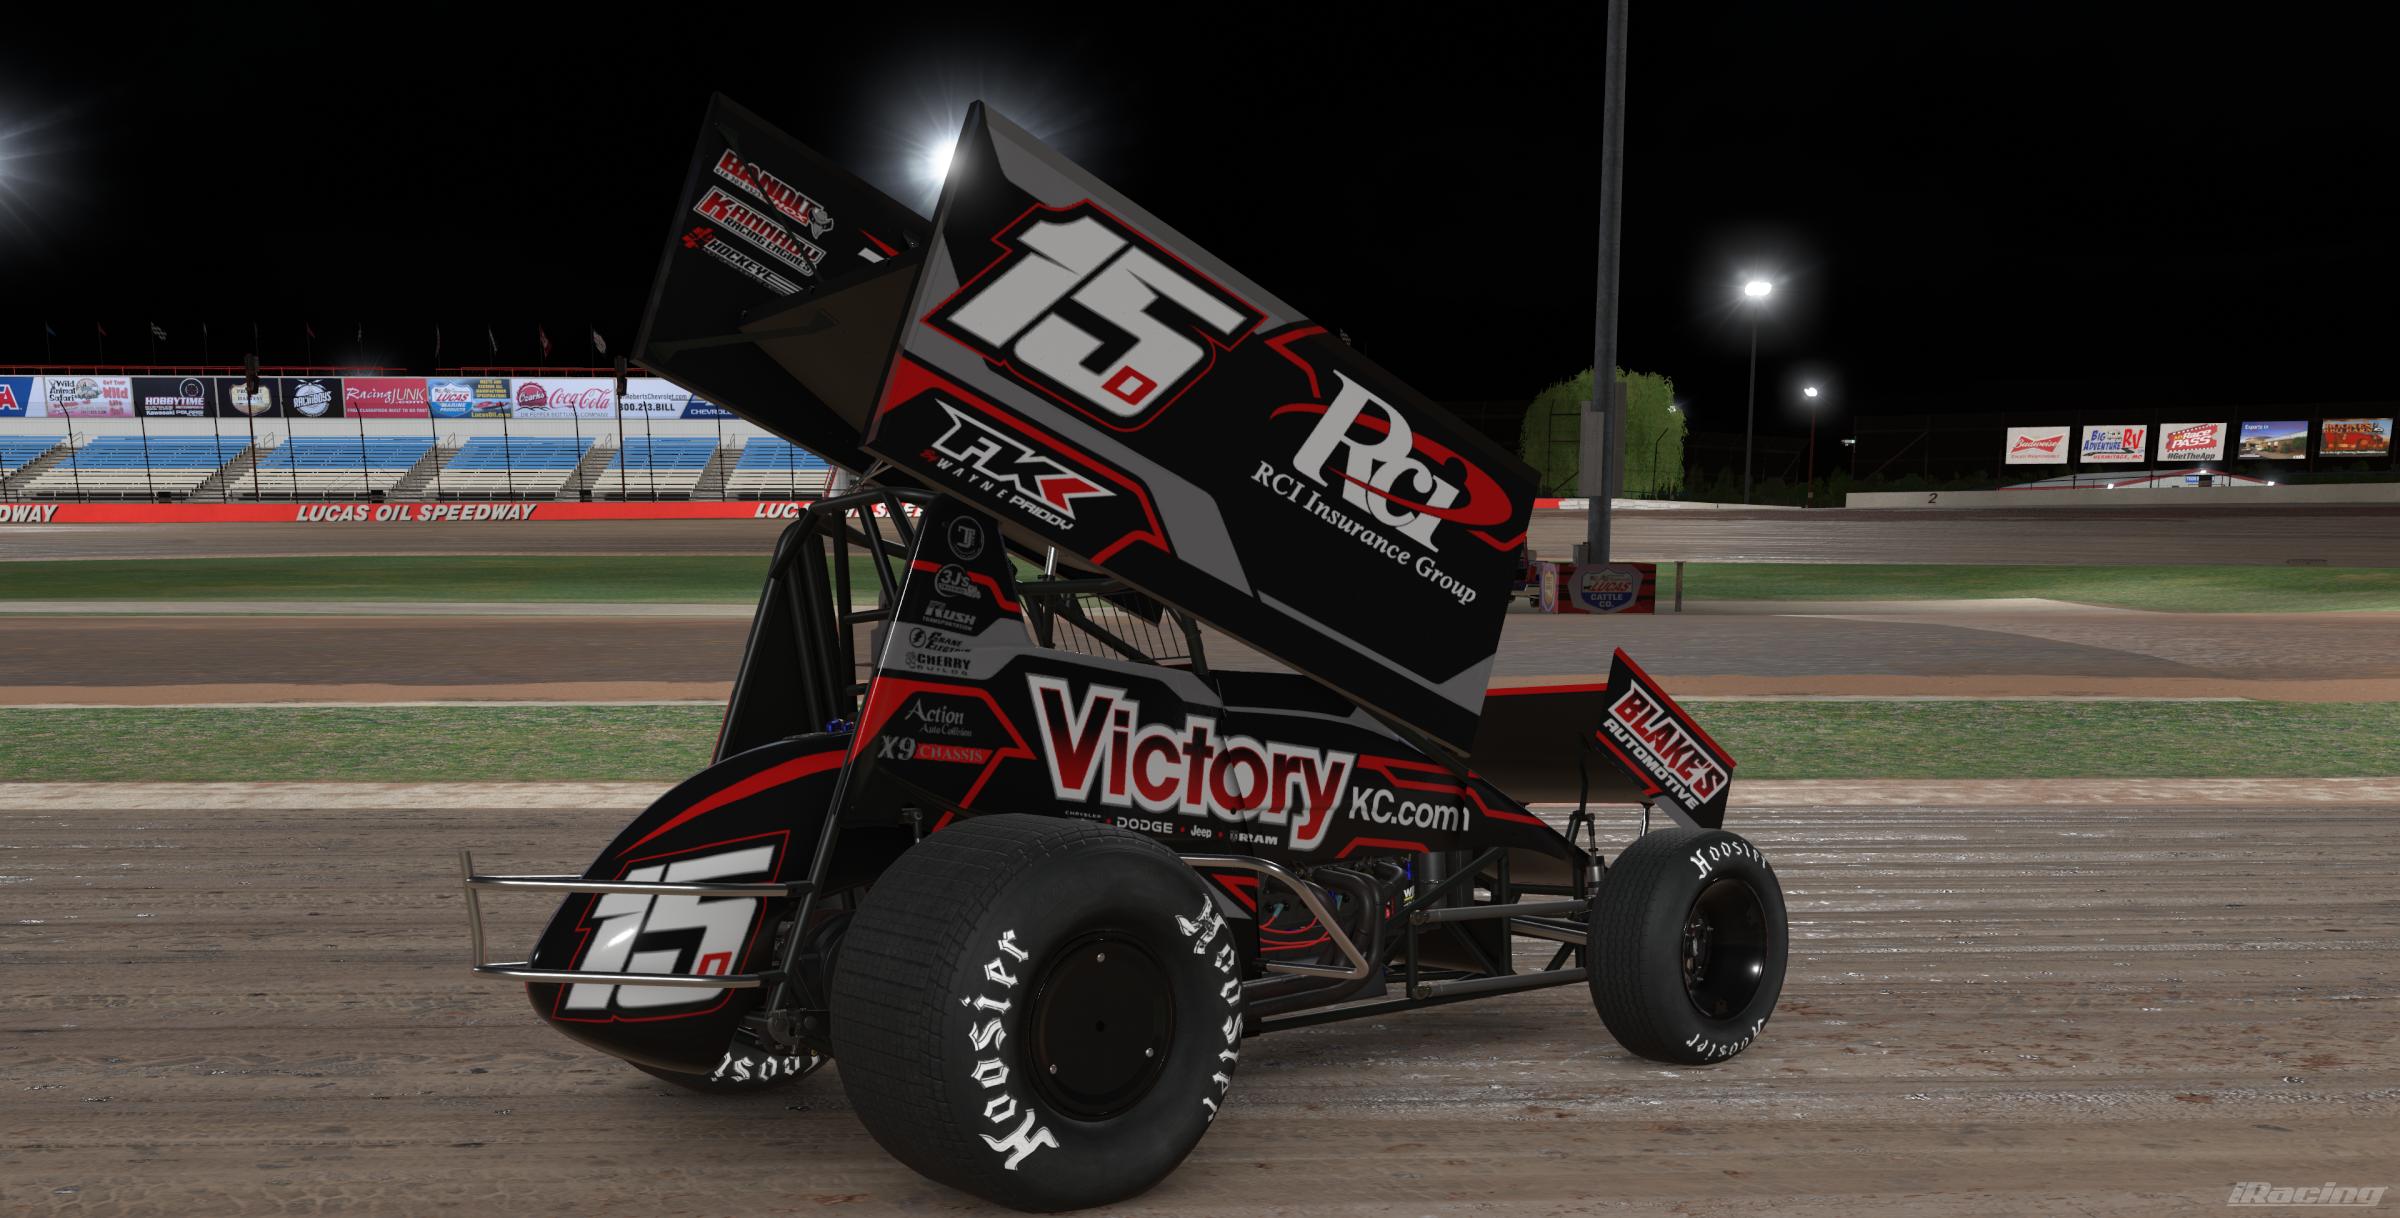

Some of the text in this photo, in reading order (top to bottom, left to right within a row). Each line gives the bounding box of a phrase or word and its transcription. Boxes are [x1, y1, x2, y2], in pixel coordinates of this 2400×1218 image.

[723, 217, 767, 247] RACING
[766, 240, 812, 272] ENGINES
[948, 215, 1247, 418] 15
[144, 396, 205, 406] HOBBYTIME
[436, 393, 469, 402] LUCAS
[548, 387, 613, 410] Coca-Cola
[2083, 440, 2121, 451] ADVENTURE
[2122, 428, 2145, 450] RV
[2172, 436, 2211, 449] PASS
[2167, 453, 2216, 461] #GetTheApp
[936, 457, 1009, 500] WAYNE
[1009, 496, 1075, 531] PRIDDY
[1927, 492, 1938, 504] 2
[296, 504, 538, 521] LUCAS OIL SPEEDWAY
[1251, 460, 1478, 606] RCI Insurance Group
[1589, 581, 1631, 592] LUCAS
[924, 600, 977, 625] RUSH
[916, 653, 971, 671] CHERRY
[904, 698, 965, 726] Action
[877, 734, 984, 762] X9 CHASSIS
[1611, 682, 1728, 803] BLAKE'S
[1026, 672, 1356, 851] Victory
[1602, 717, 1700, 812] AUTOMOTIVE
[1116, 815, 1175, 834] DODGE
[1190, 824, 1213, 839] Jeep
[563, 844, 776, 1010] 15
[960, 928, 1061, 1171] Hoosier
